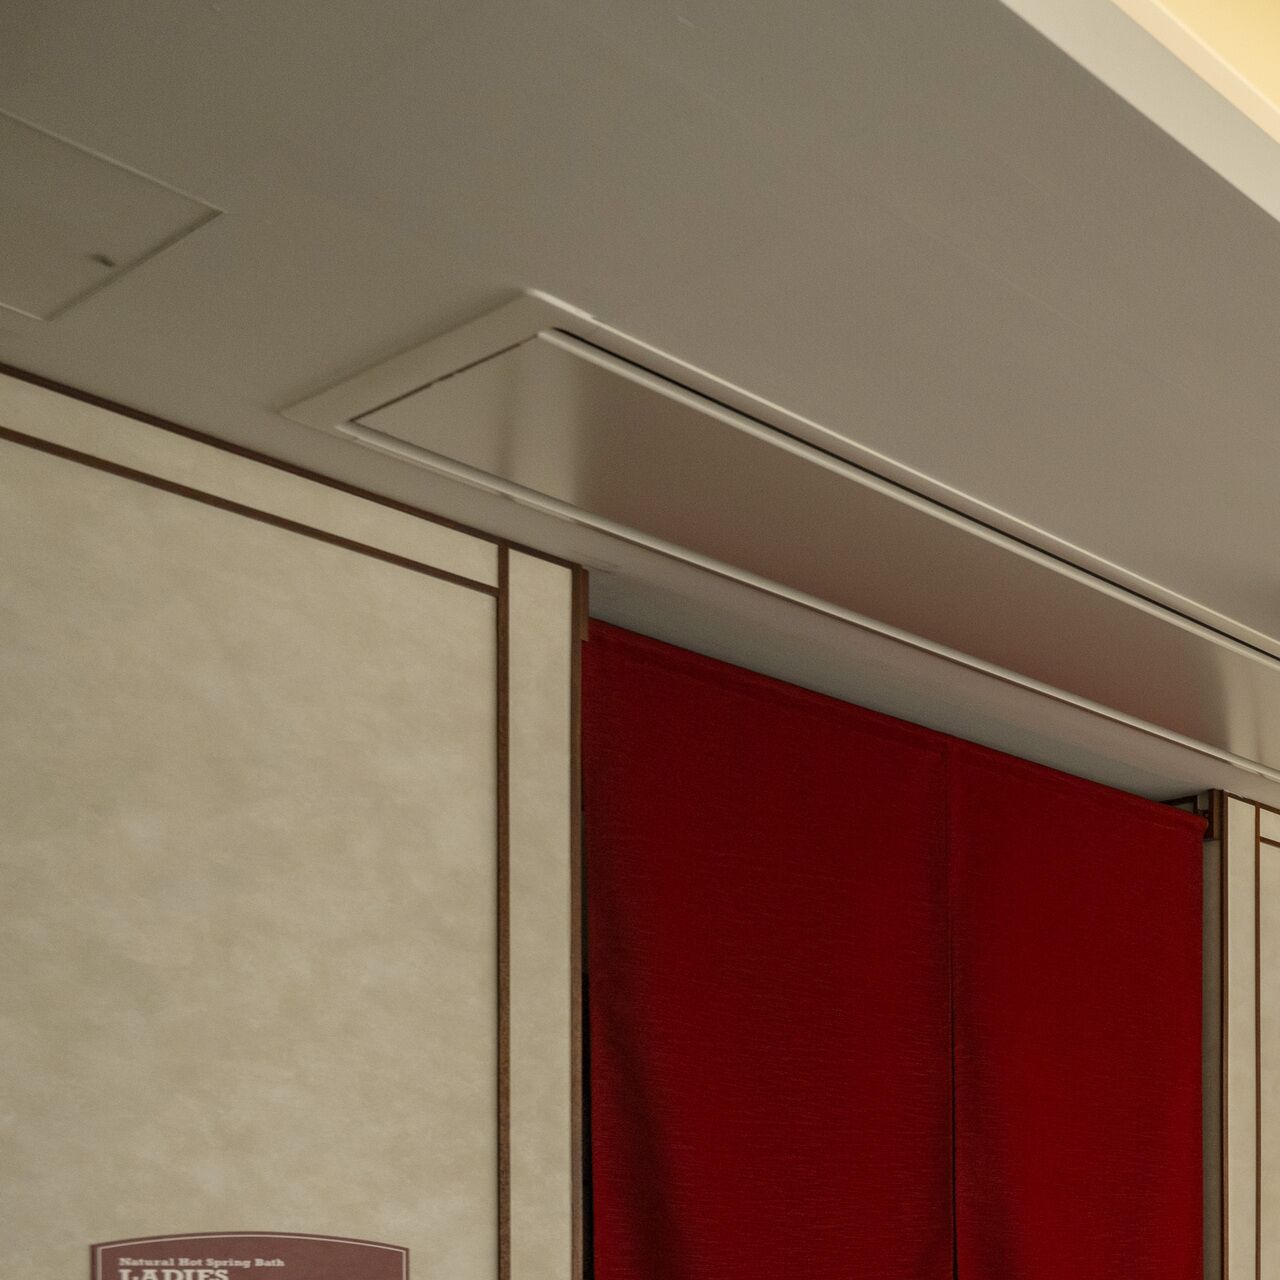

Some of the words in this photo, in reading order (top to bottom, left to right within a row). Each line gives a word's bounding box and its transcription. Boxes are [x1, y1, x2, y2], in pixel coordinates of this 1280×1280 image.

[118, 1257, 175, 1267] Natural
[178, 1257, 203, 1267] Hot
[206, 1257, 252, 1269] Spring
[254, 1258, 286, 1267] Bath
